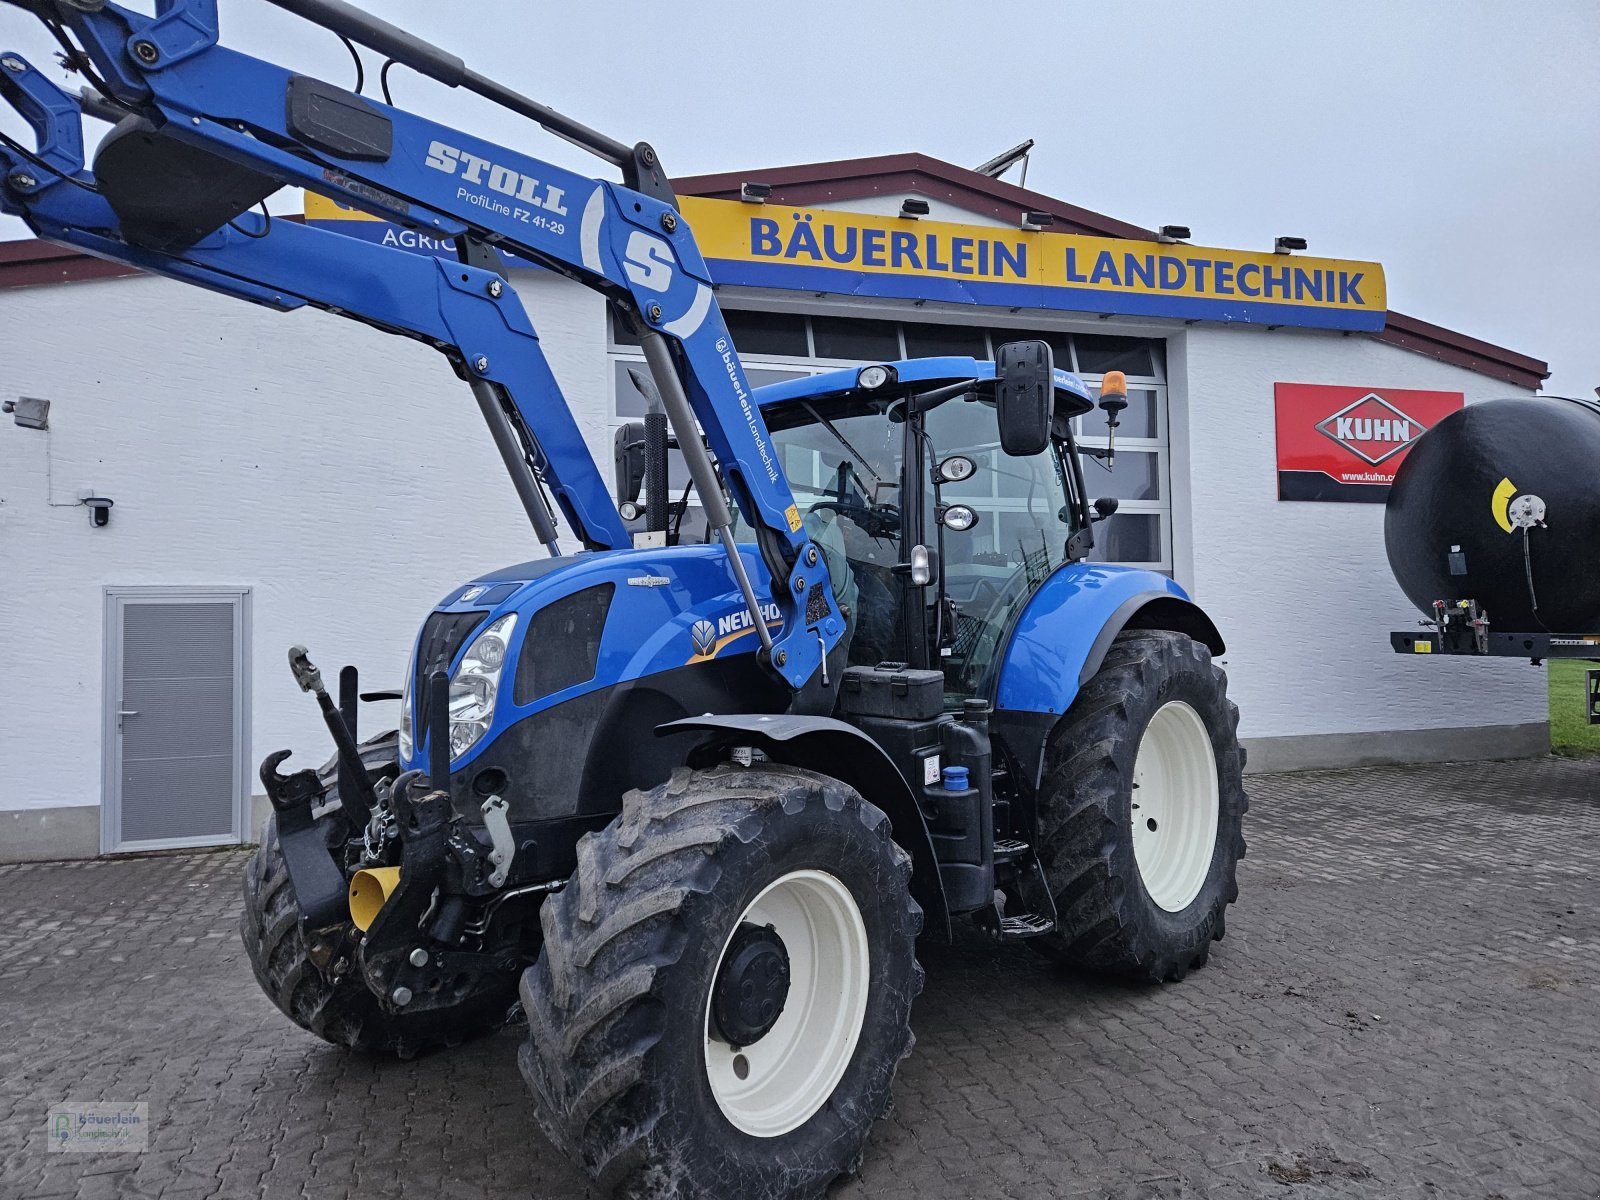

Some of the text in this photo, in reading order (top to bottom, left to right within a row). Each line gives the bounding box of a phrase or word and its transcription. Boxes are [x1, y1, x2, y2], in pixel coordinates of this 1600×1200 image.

[425, 140, 568, 217] STOLL
[457, 187, 565, 235] ProfiLine FZ 41-29
[623, 229, 676, 293] S
[750, 212, 1366, 306] BÄUERLEIN LANDTECHNIK
[722, 351, 752, 421] bäuerlein
[749, 418, 780, 485] Landtechnik
[1336, 416, 1410, 442] KUHN
[718, 603, 783, 636] NEW HO
